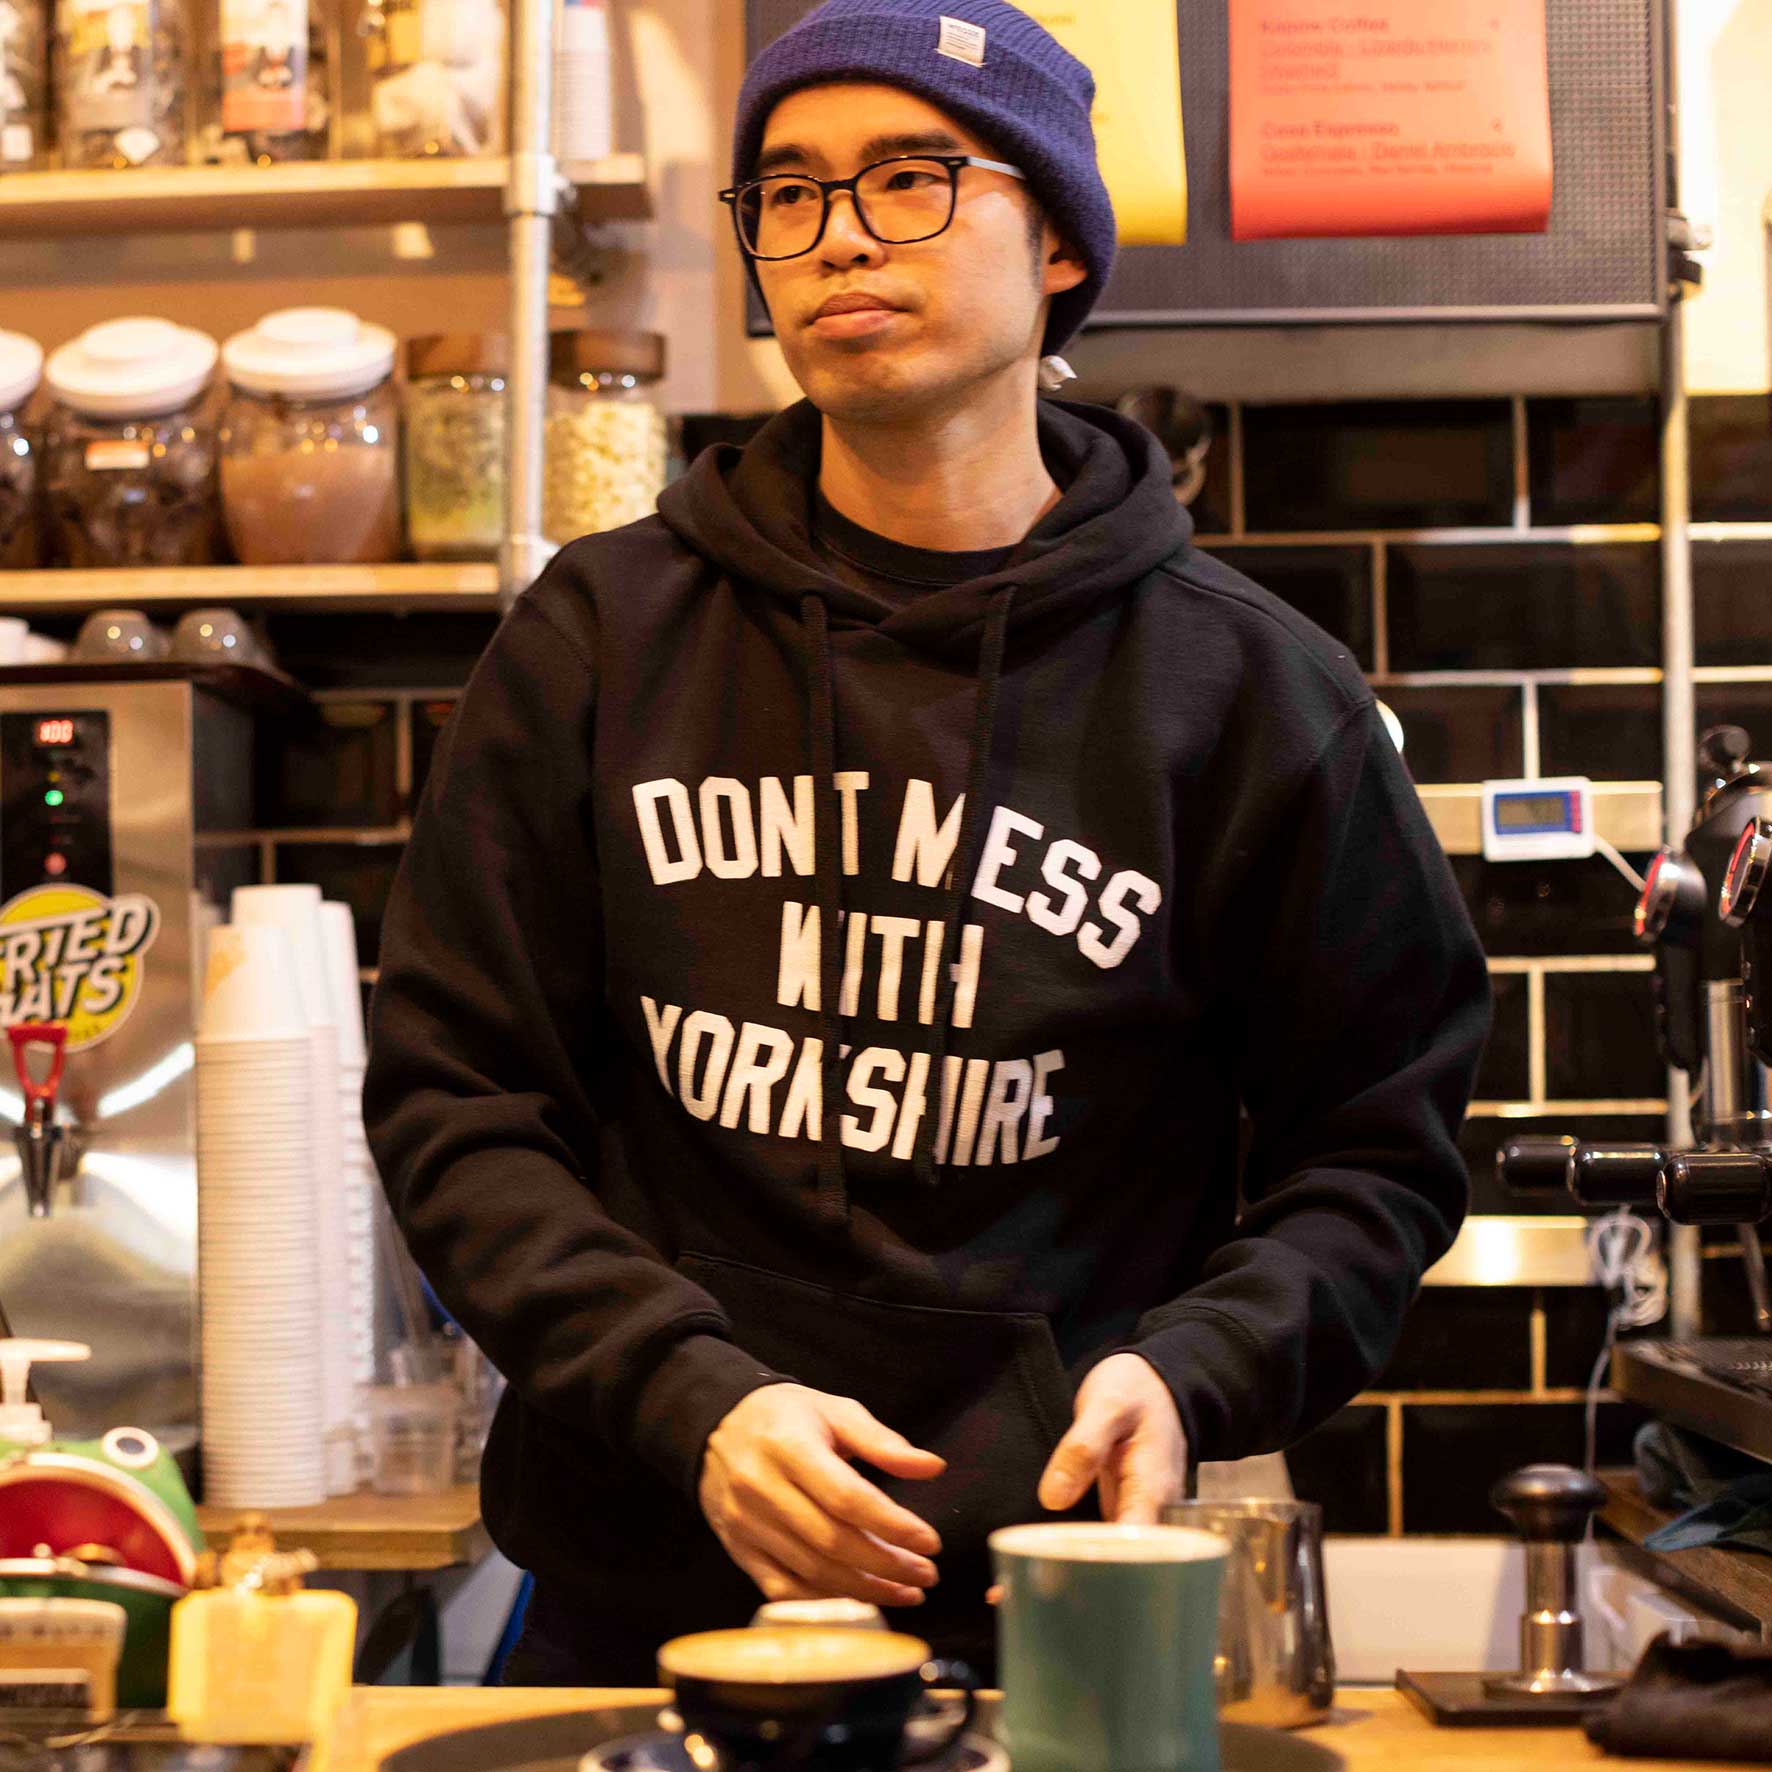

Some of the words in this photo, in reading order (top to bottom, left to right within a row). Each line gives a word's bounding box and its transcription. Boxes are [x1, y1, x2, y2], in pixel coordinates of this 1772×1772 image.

[892, 778, 1162, 969] MESS
[777, 901, 984, 1029] WITH
[640, 995, 1065, 1166] YORKSHIRE
